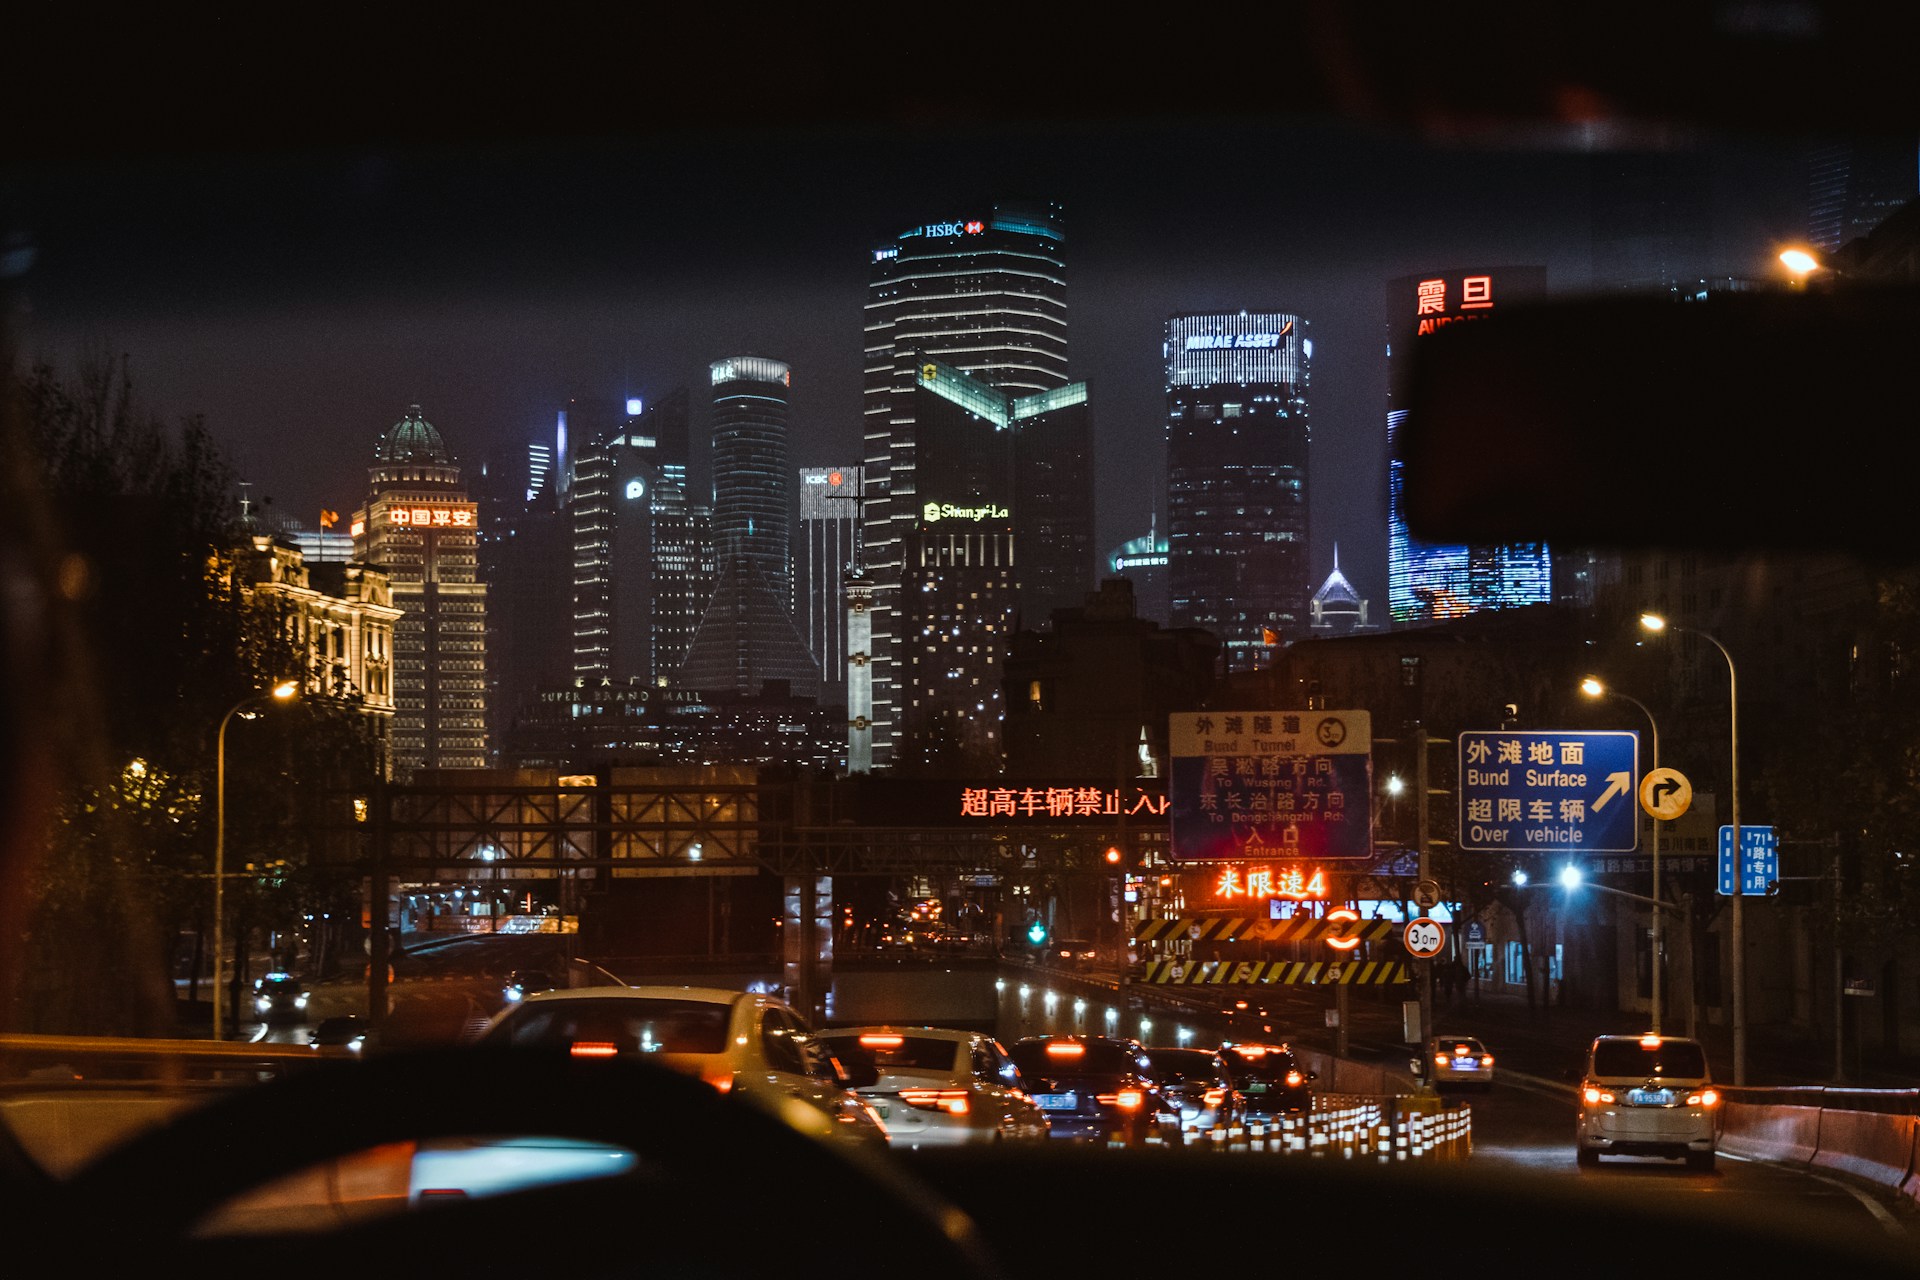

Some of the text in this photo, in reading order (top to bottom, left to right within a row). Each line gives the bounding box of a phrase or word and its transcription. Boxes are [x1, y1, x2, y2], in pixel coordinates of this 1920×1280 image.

[926, 223, 963, 237] HSBC
[1417, 275, 1494, 315] 震旦
[1187, 334, 1279, 349] MIRAE ASSET
[390, 509, 472, 526] 中国平安
[941, 504, 1008, 522] Shangri-La
[541, 692, 581, 702] SUPER
[663, 691, 702, 702] MALL
[1195, 716, 1301, 735] 外滩隧道
[1205, 738, 1296, 752] Bund Tunnel
[1466, 740, 1585, 765] 外滩地面
[1217, 778, 1232, 788] To
[1243, 777, 1292, 789] Wusong
[1467, 769, 1587, 787] Bund Surface
[1208, 813, 1224, 823] To
[1467, 798, 1586, 823] 超限车辆
[1246, 826, 1299, 845] 入口
[1470, 826, 1583, 843] Over vehicle
[1244, 846, 1300, 857] Entrance
